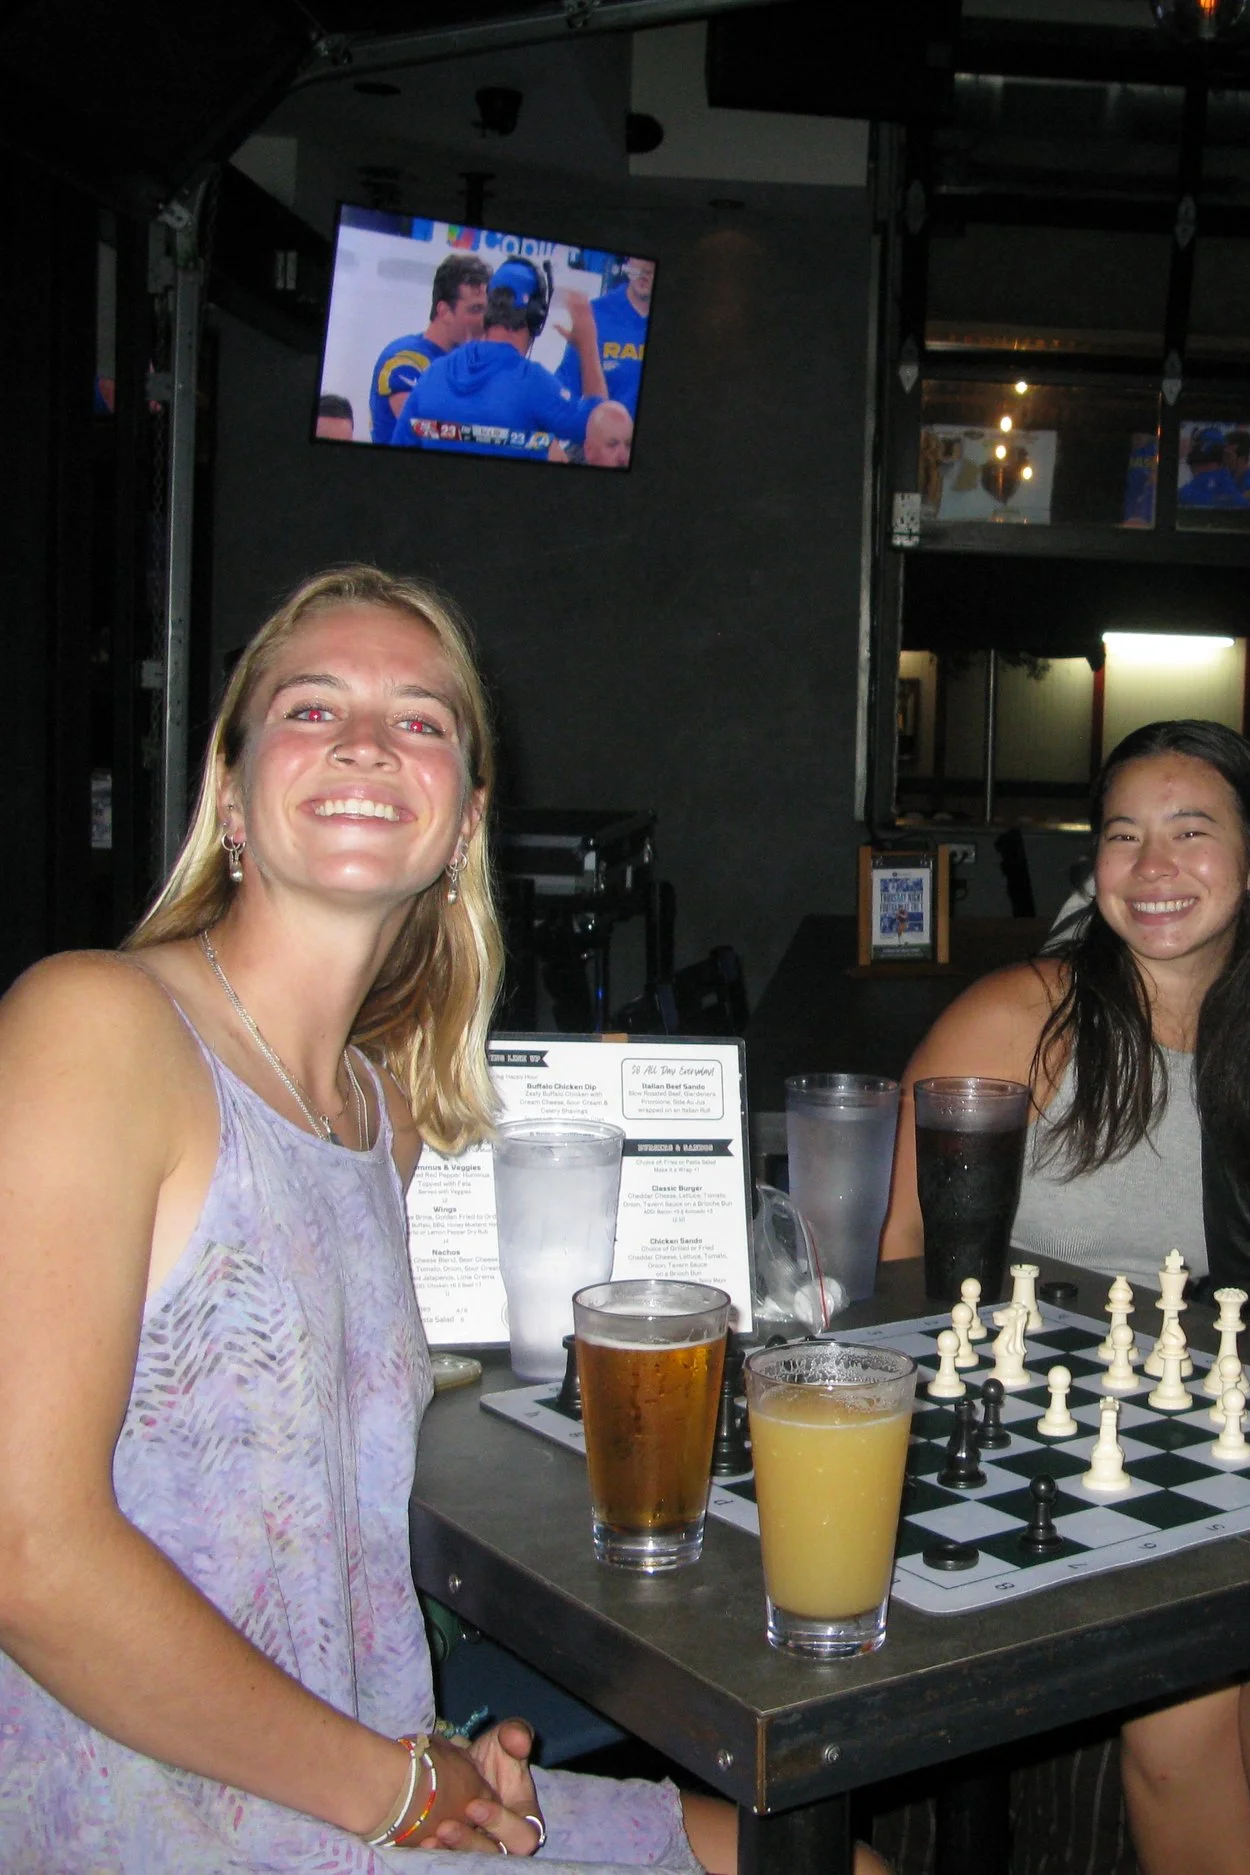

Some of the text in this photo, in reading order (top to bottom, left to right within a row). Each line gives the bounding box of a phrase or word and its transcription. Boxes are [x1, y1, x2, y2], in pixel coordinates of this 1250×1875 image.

[440, 424, 457, 438] 23
[510, 432, 525, 445] 23
[585, 1083, 596, 1091] Dip
[1068, 1562, 1088, 1571] 7
[1138, 1542, 1158, 1551] 6
[1206, 1523, 1226, 1532] 5
